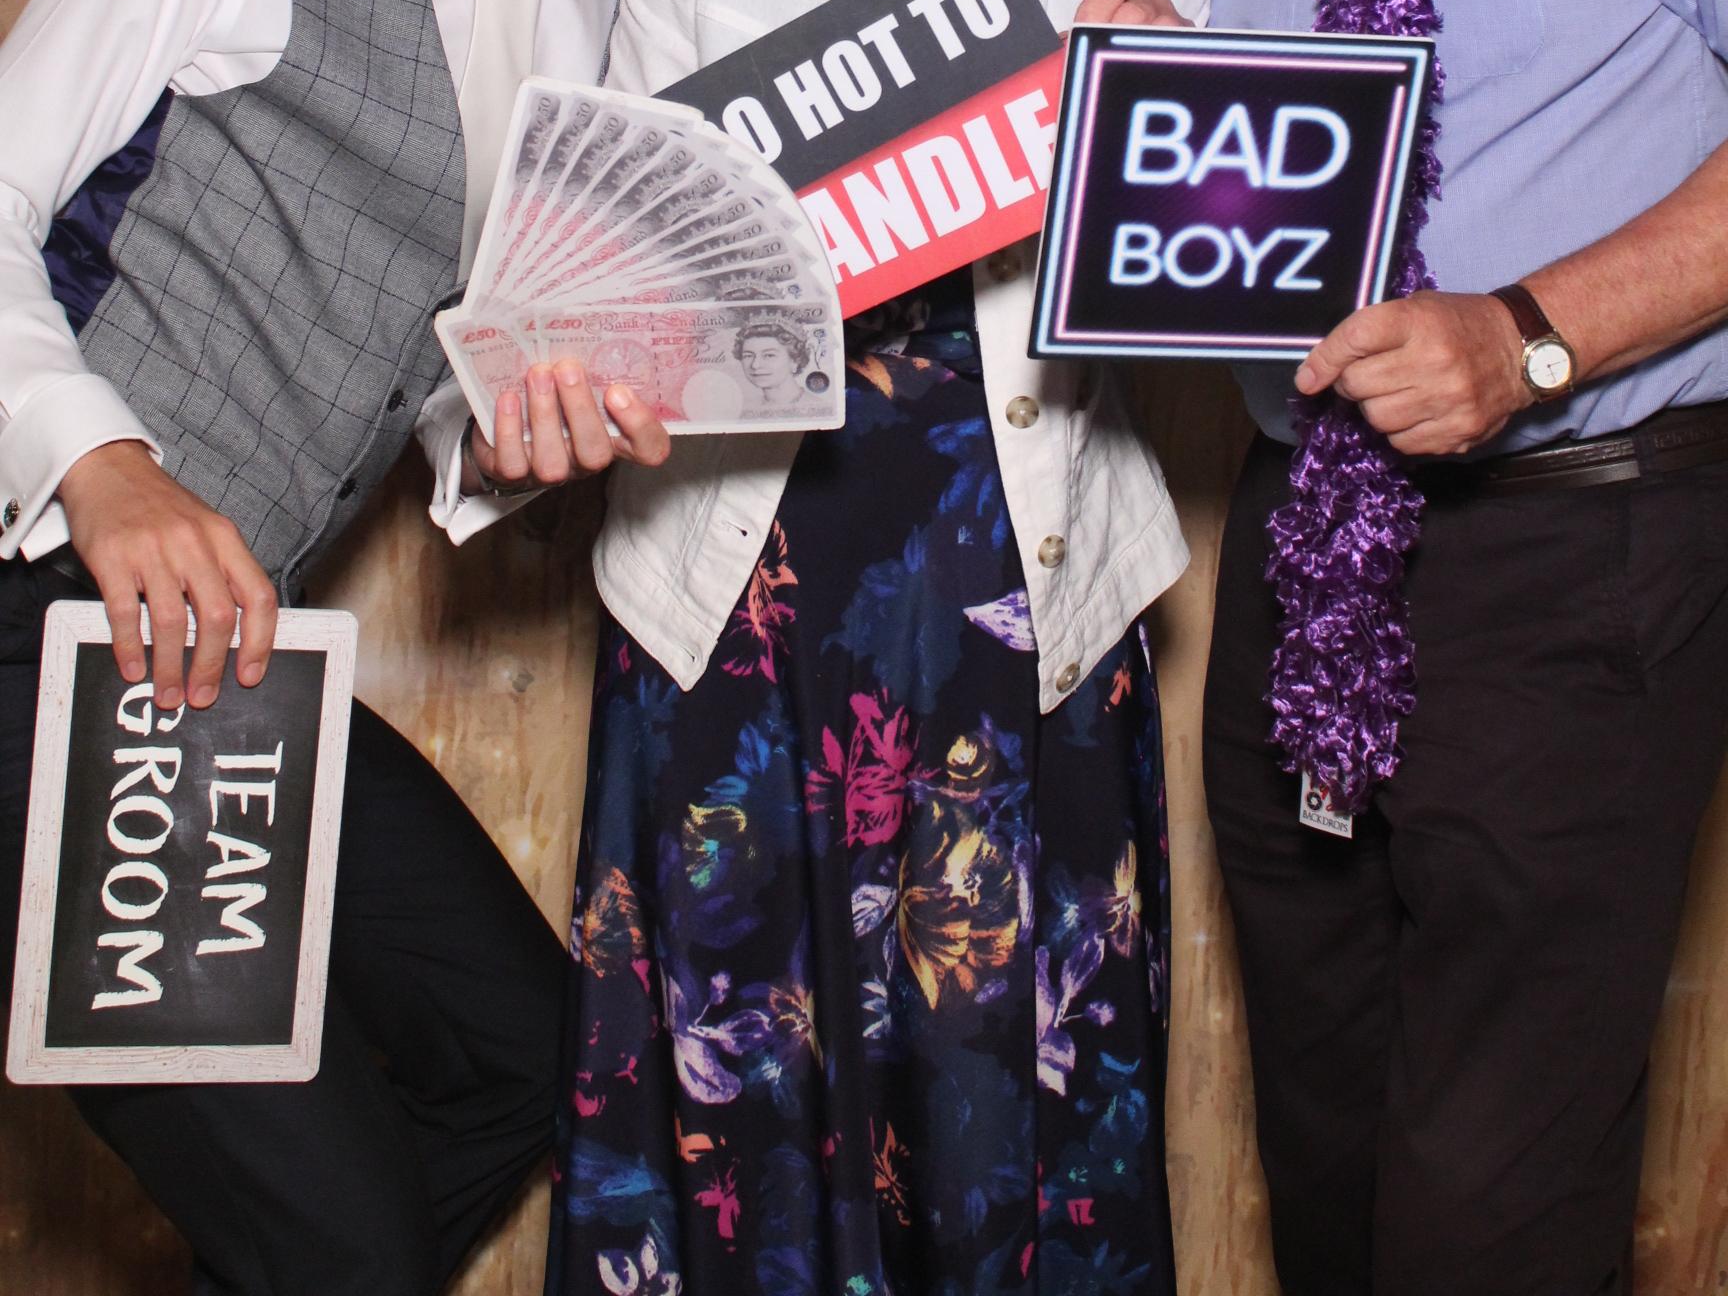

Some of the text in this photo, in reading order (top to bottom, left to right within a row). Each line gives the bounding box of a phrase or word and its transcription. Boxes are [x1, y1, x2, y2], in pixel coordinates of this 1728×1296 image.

[773, 12, 917, 141] HOT
[798, 88, 1056, 285] ANDLE
[1122, 99, 1351, 189] BAD
[1108, 222, 1332, 290] BOYZ
[463, 327, 497, 344] £50
[544, 318, 583, 331] £50
[91, 682, 186, 1010] GROOM
[196, 740, 284, 956] TEAM
[1302, 809, 1349, 833] BACKDROPS
